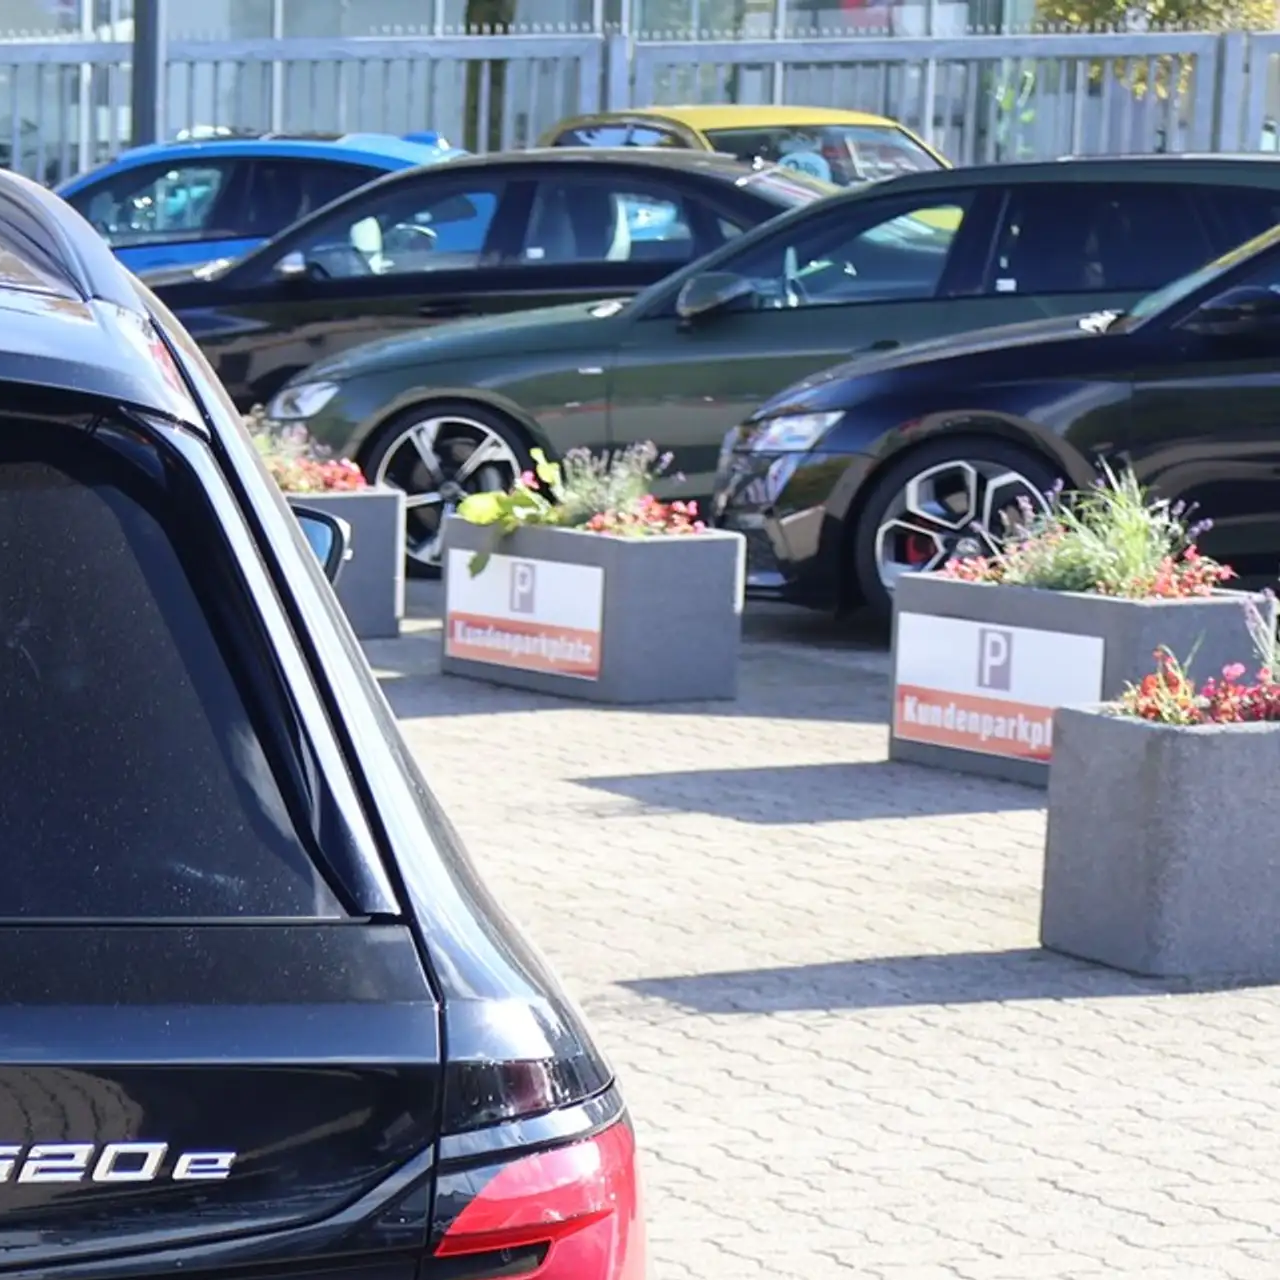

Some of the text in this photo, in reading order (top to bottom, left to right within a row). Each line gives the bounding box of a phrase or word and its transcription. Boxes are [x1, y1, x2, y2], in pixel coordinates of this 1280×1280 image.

[514, 565, 533, 610] P
[982, 632, 1008, 686] P
[903, 695, 1053, 749] Kundenparkpl
